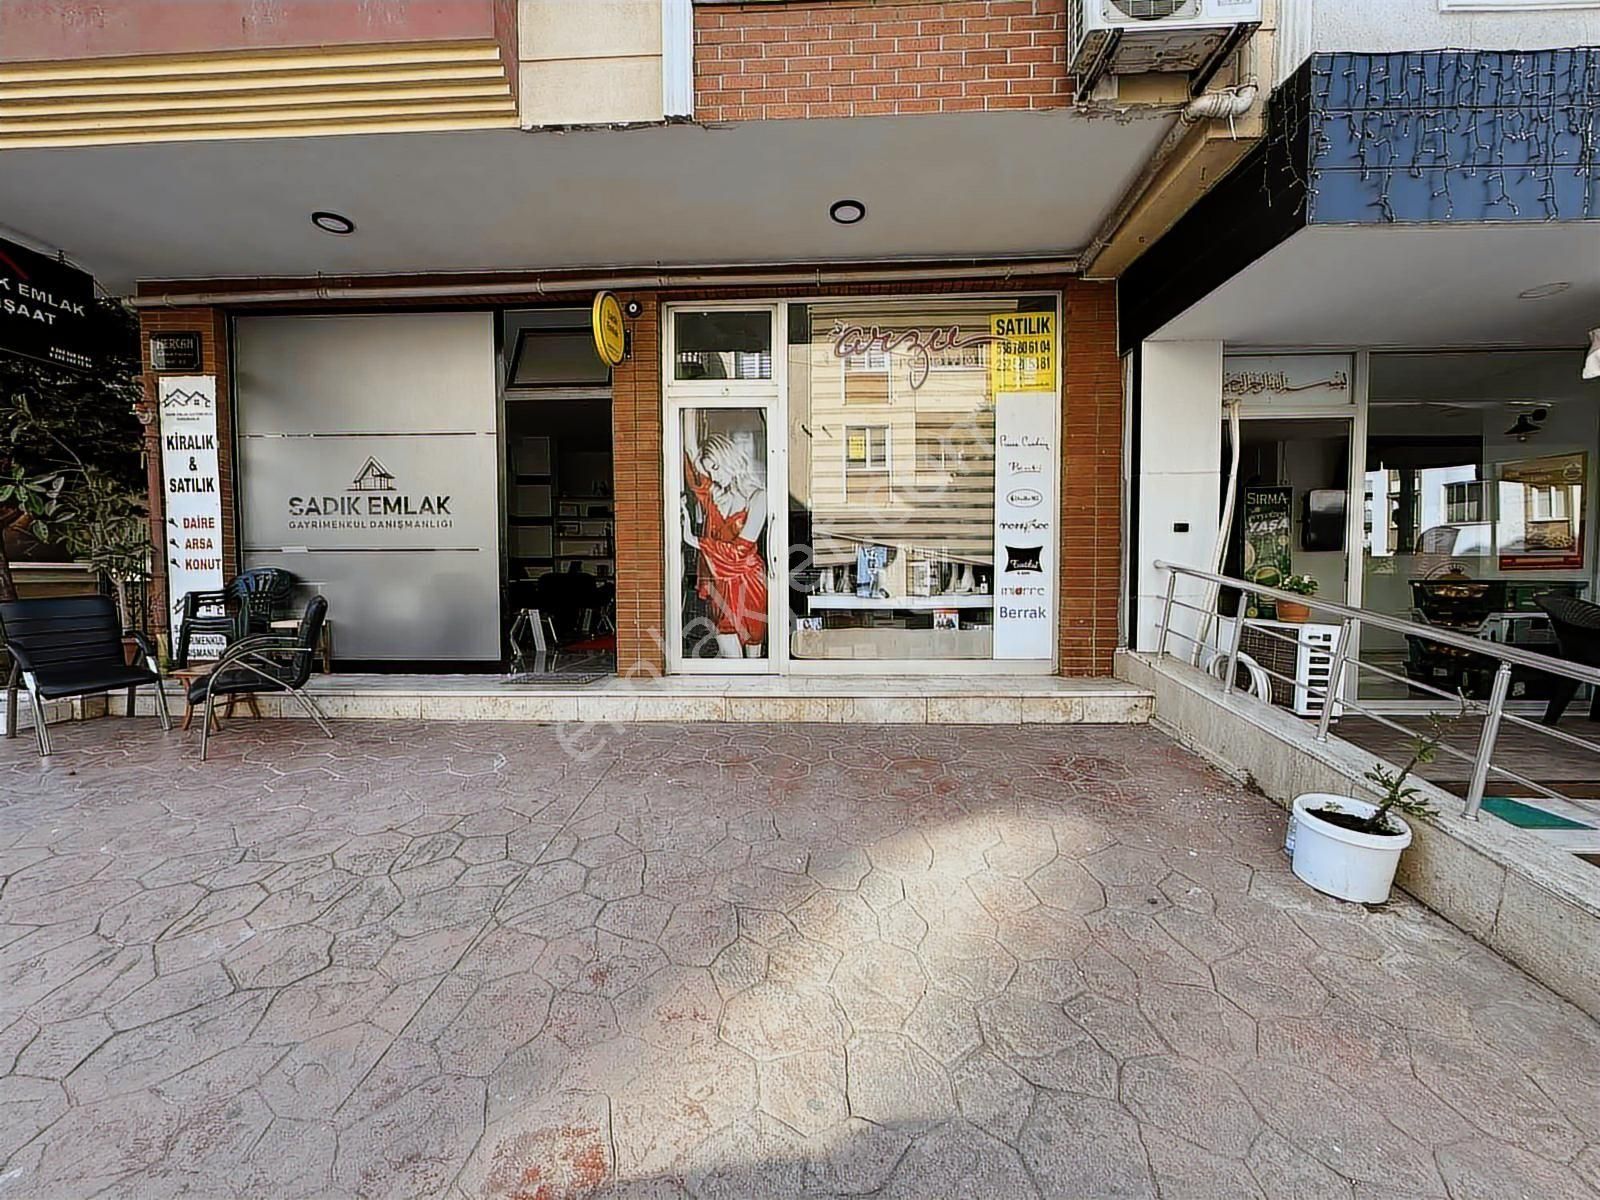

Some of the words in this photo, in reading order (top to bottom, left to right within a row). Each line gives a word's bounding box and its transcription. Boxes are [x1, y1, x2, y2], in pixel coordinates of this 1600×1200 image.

[18, 283, 85, 317] EMLAK
[996, 316, 1050, 336] SATILIK
[166, 432, 214, 450] KİRALIK
[188, 456, 198, 472] &
[169, 477, 215, 493] SATILIK
[289, 497, 361, 516] SADIK
[368, 496, 451, 515] EMLAK
[1247, 492, 1288, 505] SIRMA
[183, 515, 215, 529] DAİRE
[185, 538, 213, 550] ARSA
[185, 558, 222, 571] KONUT
[1000, 606, 1047, 619] Berrak
